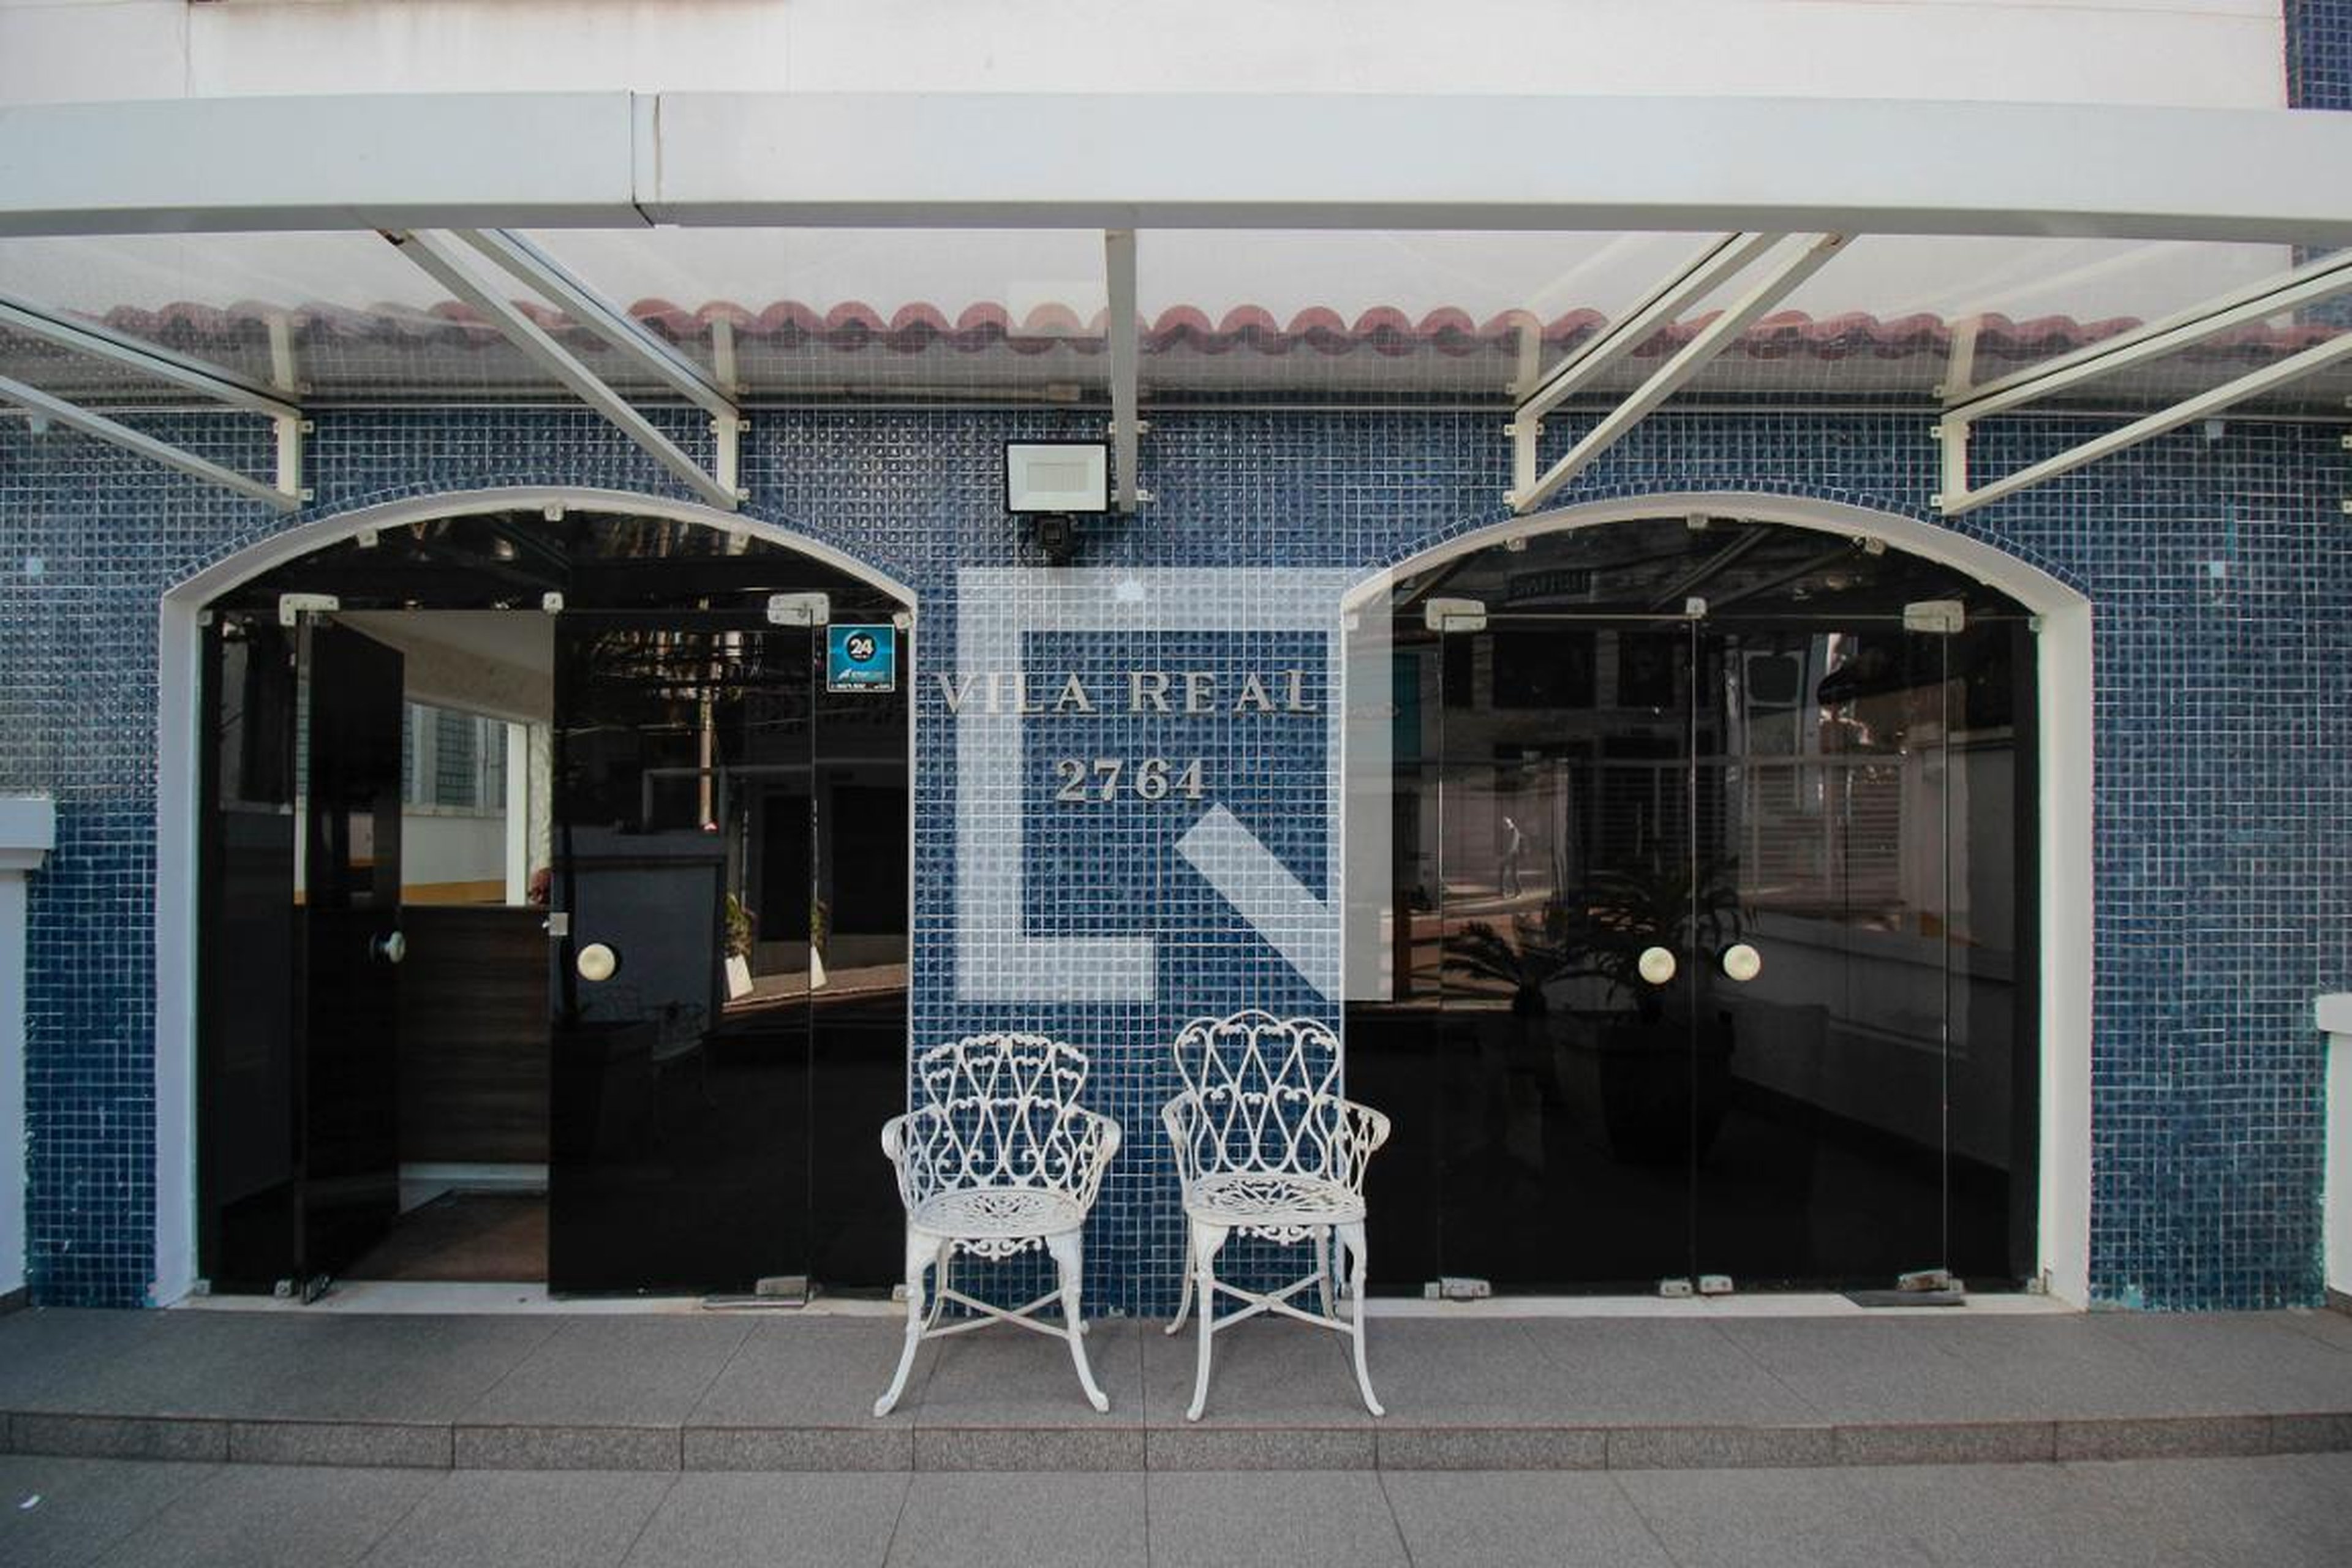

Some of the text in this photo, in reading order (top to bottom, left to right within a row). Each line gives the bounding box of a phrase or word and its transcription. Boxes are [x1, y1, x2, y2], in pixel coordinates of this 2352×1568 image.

[849, 638, 874, 655] 24
[934, 669, 1318, 714] VILA REAL
[1056, 758, 1205, 804] 2764
